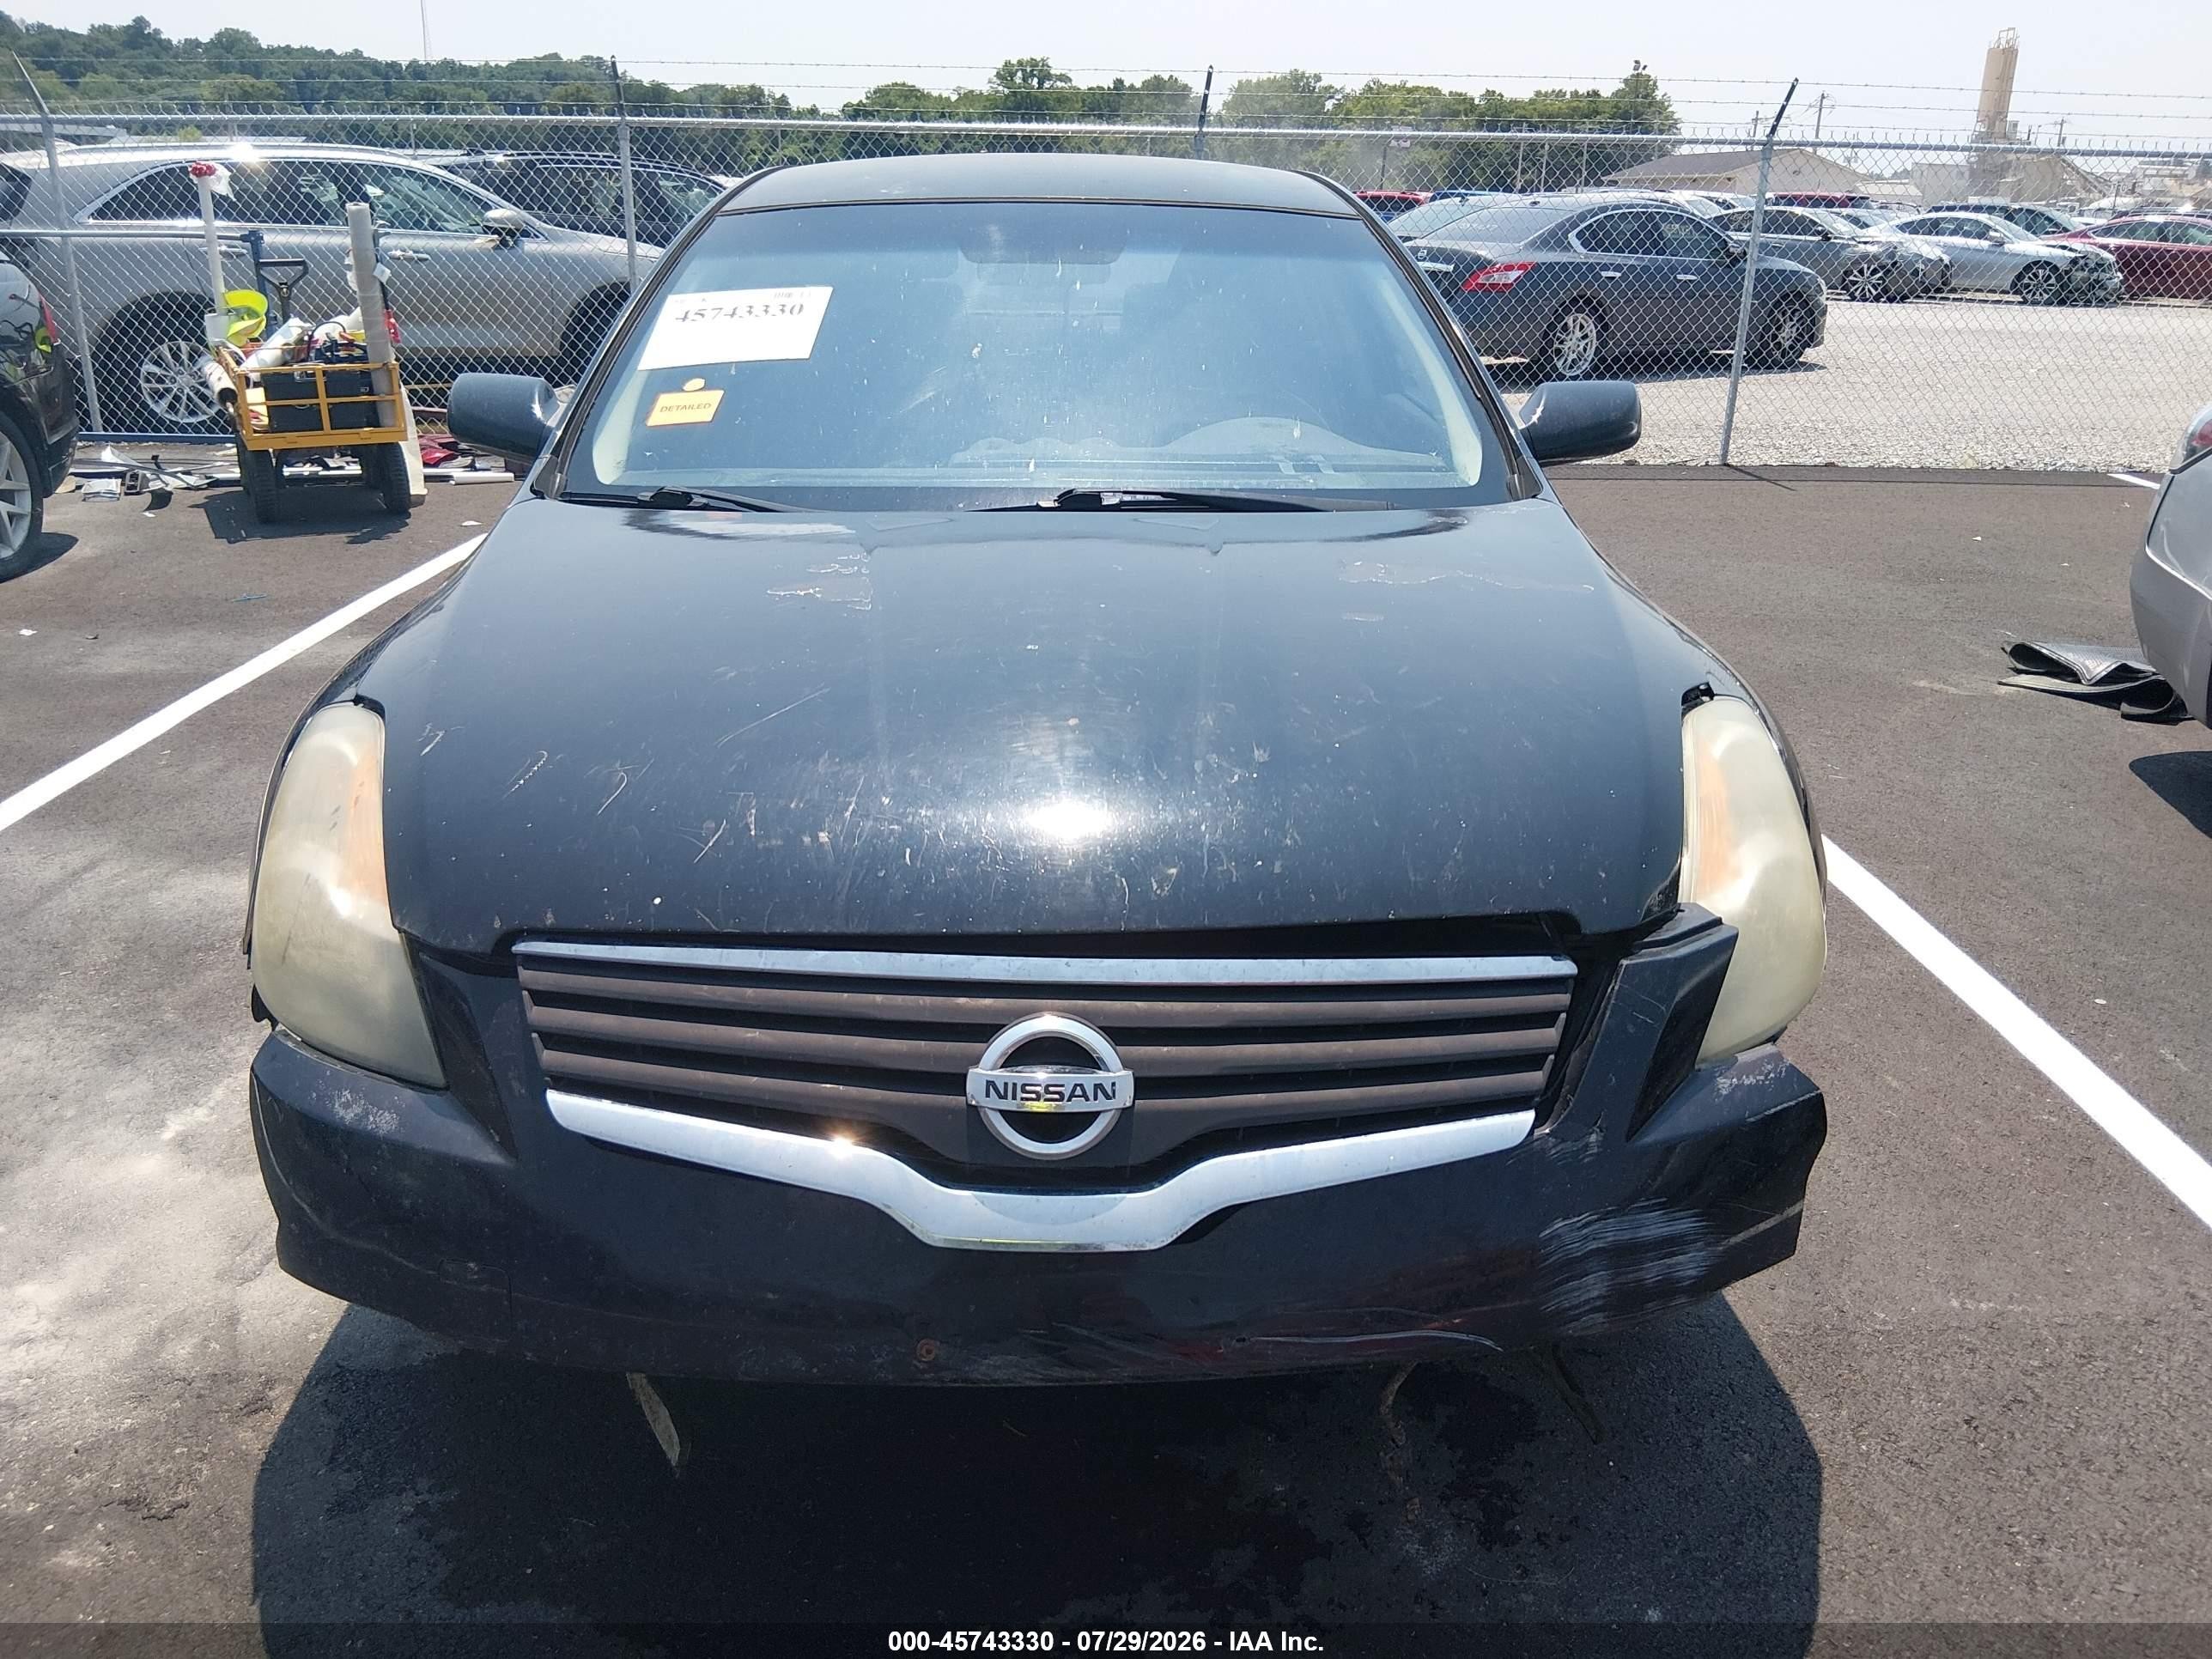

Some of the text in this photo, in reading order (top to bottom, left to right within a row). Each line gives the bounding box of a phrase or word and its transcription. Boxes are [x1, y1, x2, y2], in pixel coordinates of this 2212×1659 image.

[674, 302, 805, 323] 45743330
[659, 403, 712, 413] DETAILED
[985, 1079, 1116, 1103] NISSAN
